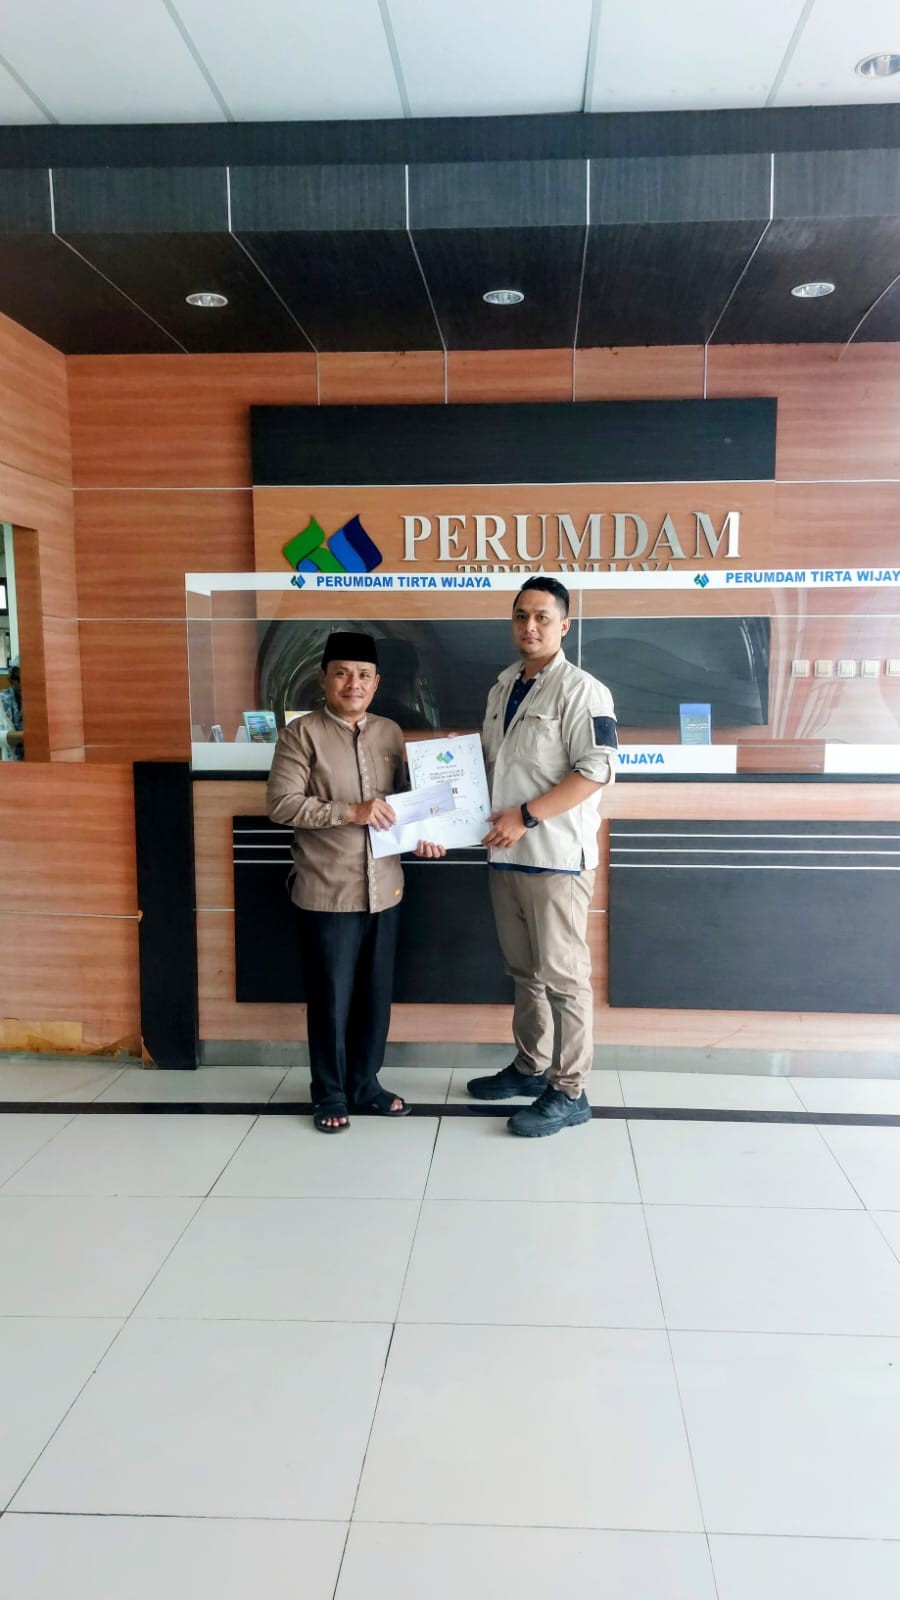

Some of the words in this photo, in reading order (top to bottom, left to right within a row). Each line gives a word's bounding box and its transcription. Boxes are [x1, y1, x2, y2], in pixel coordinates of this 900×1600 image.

[400, 511, 743, 562] PERUMDAM
[316, 576, 393, 588] PERUMDAM
[397, 576, 437, 588] TIRTA
[441, 576, 492, 588] WIJAYA
[725, 571, 806, 583] PERUMDAM
[811, 571, 852, 582] TIRTA
[857, 570, 900, 582] WIJAY
